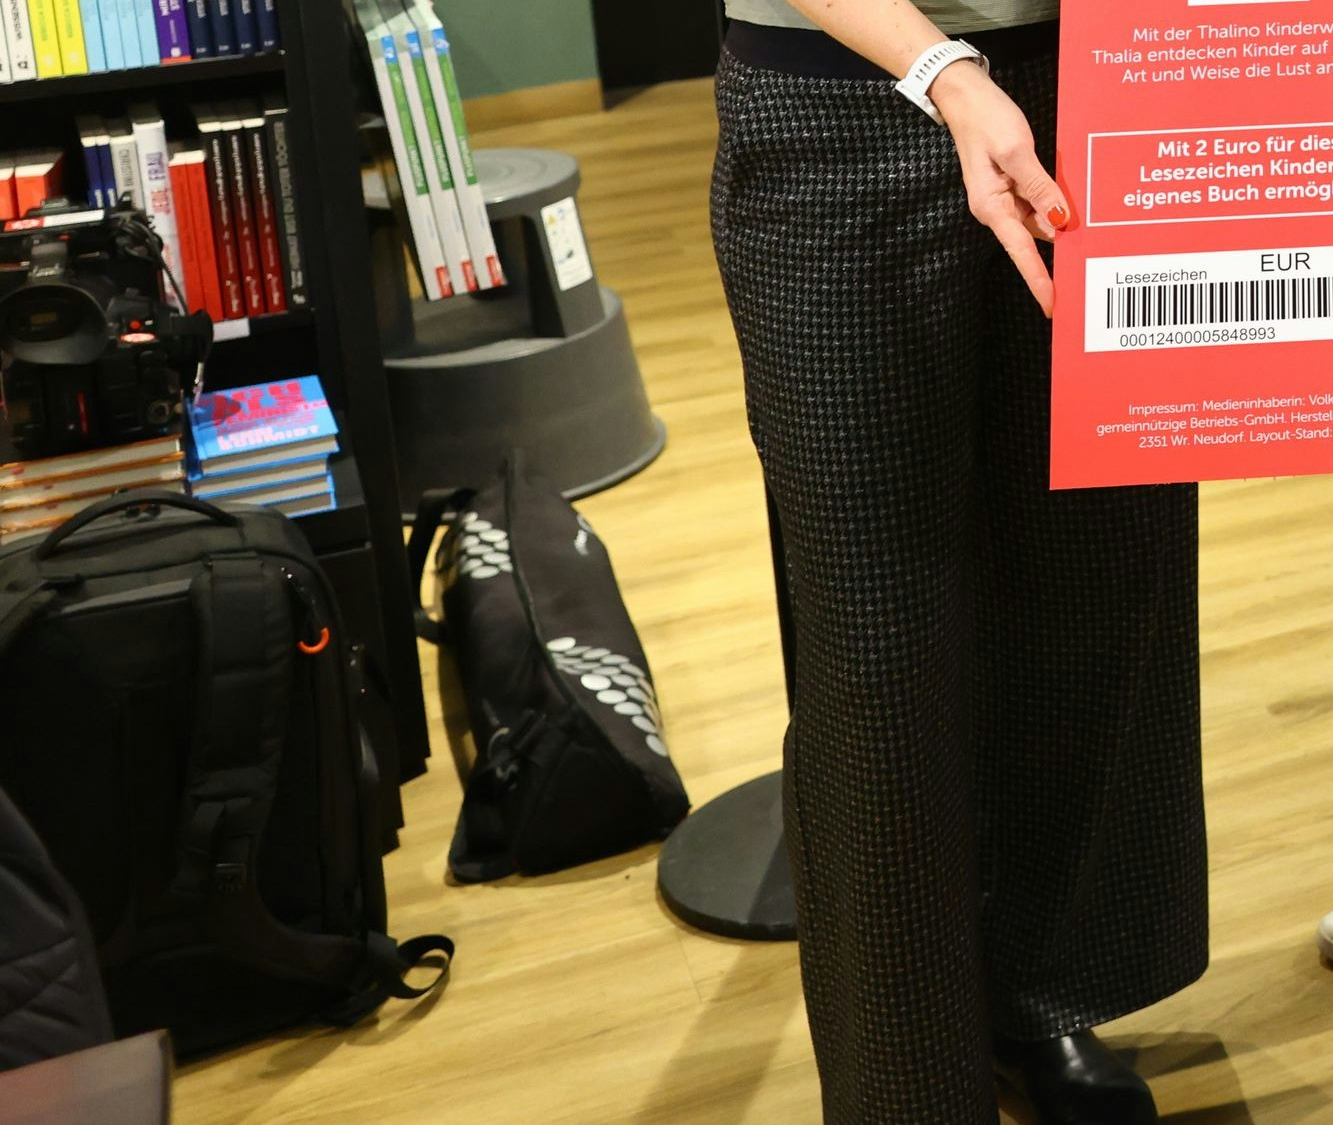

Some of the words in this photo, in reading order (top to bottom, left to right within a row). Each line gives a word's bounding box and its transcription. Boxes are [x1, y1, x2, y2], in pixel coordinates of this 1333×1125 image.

[1133, 27, 1160, 42] Mit
[1164, 26, 1192, 41] der
[1197, 23, 1261, 39] Thalino
[1092, 49, 1142, 65] Thalia
[1148, 44, 1236, 62] entdecken
[1242, 42, 1296, 58] Kinder
[1301, 39, 1328, 56] auf
[1122, 69, 1146, 83] Art
[1152, 66, 1184, 82] und
[1190, 63, 1240, 80] Weise
[1245, 62, 1271, 78] die
[1276, 60, 1311, 76] Lust
[1157, 141, 1190, 158] Mit
[1195, 140, 1207, 155] 2
[1214, 138, 1261, 155] Euro
[1265, 136, 1295, 153] für
[1139, 163, 1264, 183] Lesezeichen
[1123, 188, 1202, 210] eigenes
[1208, 184, 1259, 202] Buch
[1260, 252, 1310, 272] EUR
[1115, 268, 1207, 285] Lesezeichen
[1119, 327, 1276, 347] 00012400005848993
[1128, 400, 1198, 416] Impressum:
[1202, 395, 1305, 411] Medieninhaberin:
[1097, 417, 1187, 436] gemeinnützige
[1190, 411, 1287, 428] Betriebs-GmbH.
[1138, 434, 1168, 449] 2351
[1171, 433, 1189, 447] Wr.
[1193, 429, 1247, 444] Neudorf.
[1249, 424, 1332, 443] Layout-Stand:
